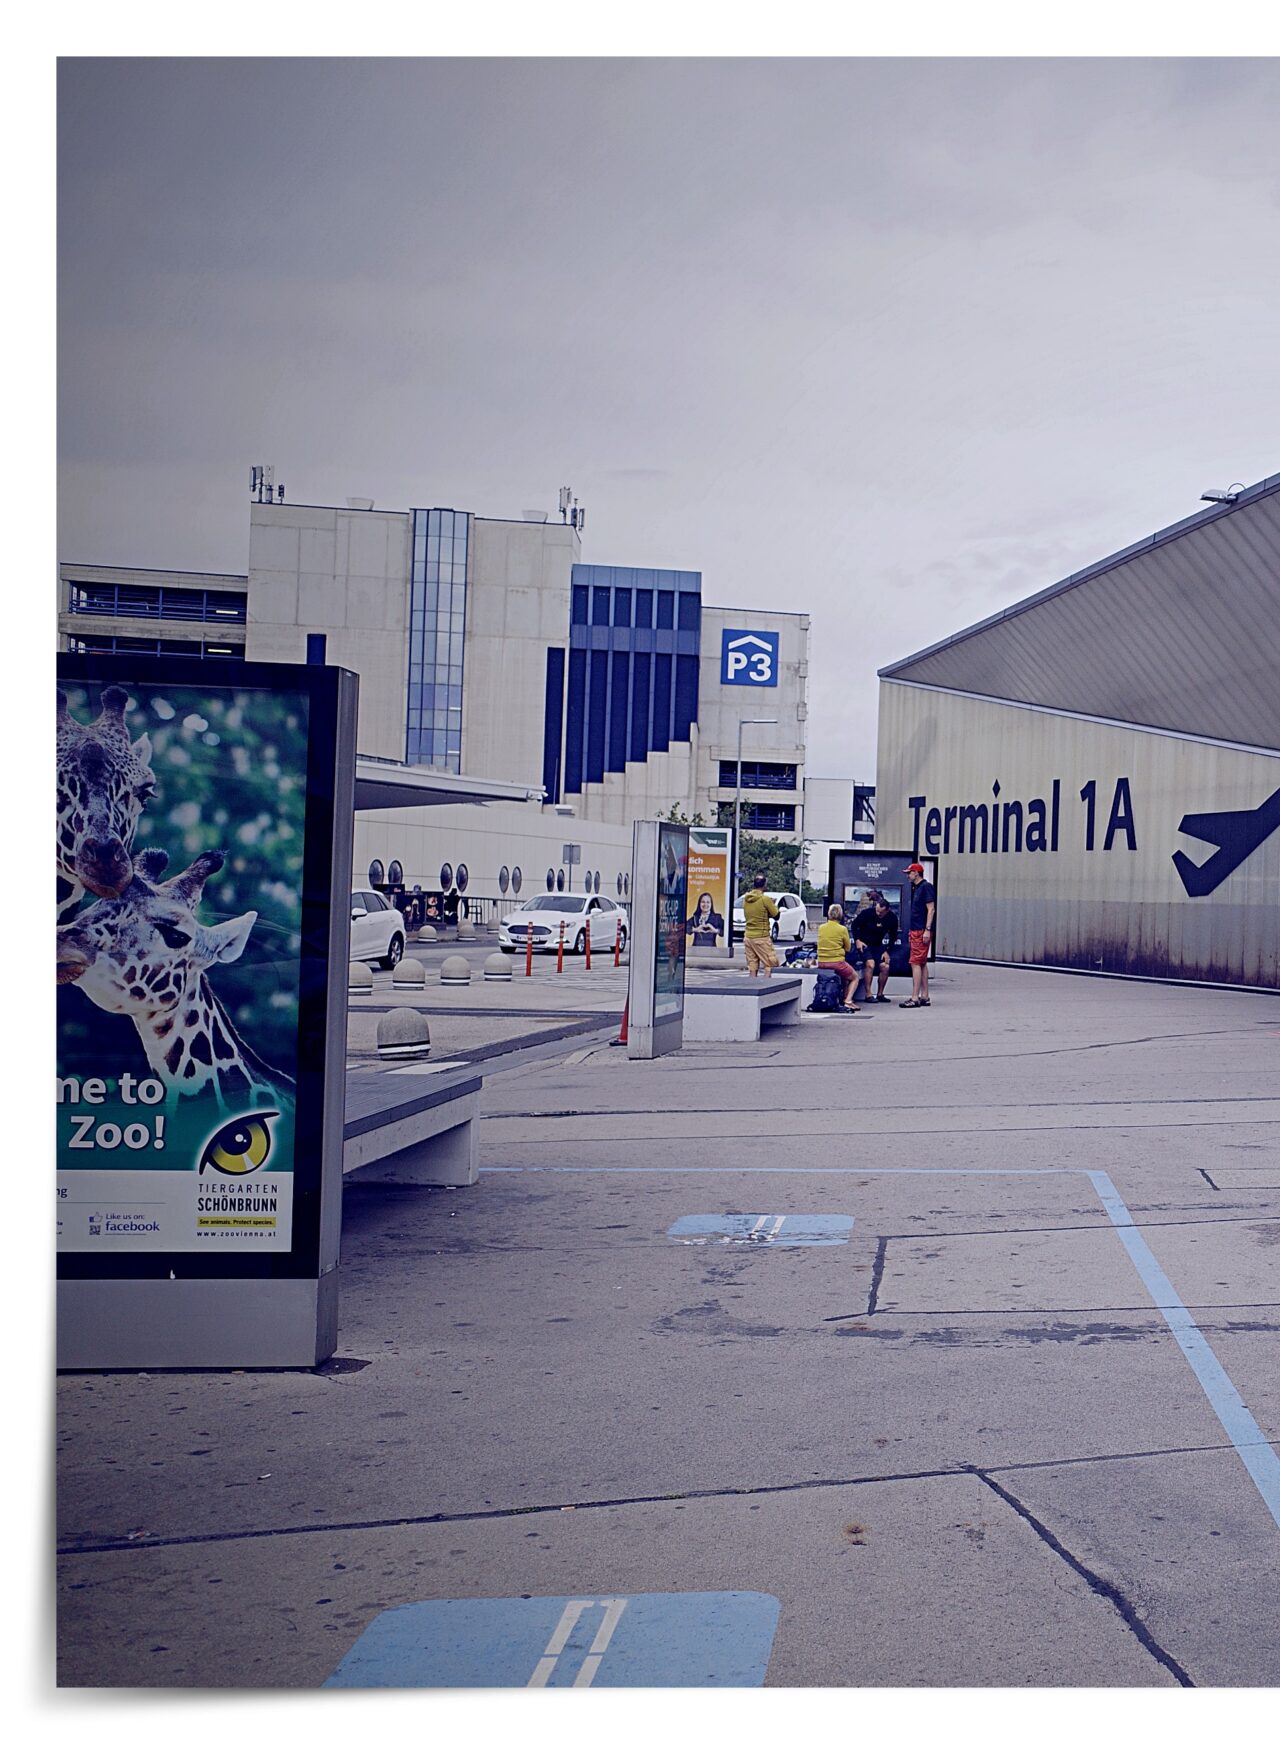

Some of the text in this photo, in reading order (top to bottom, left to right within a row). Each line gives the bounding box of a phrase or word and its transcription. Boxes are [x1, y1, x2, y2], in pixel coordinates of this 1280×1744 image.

[727, 651, 772, 682] P3
[908, 777, 1137, 854] Terminal 1A
[118, 1072, 164, 1104] to
[68, 1115, 165, 1149] Zoo!
[197, 1195, 277, 1212] SCHÖNBRUNN
[198, 1183, 278, 1194] TIERGARTEN
[105, 1221, 160, 1231] facebook
